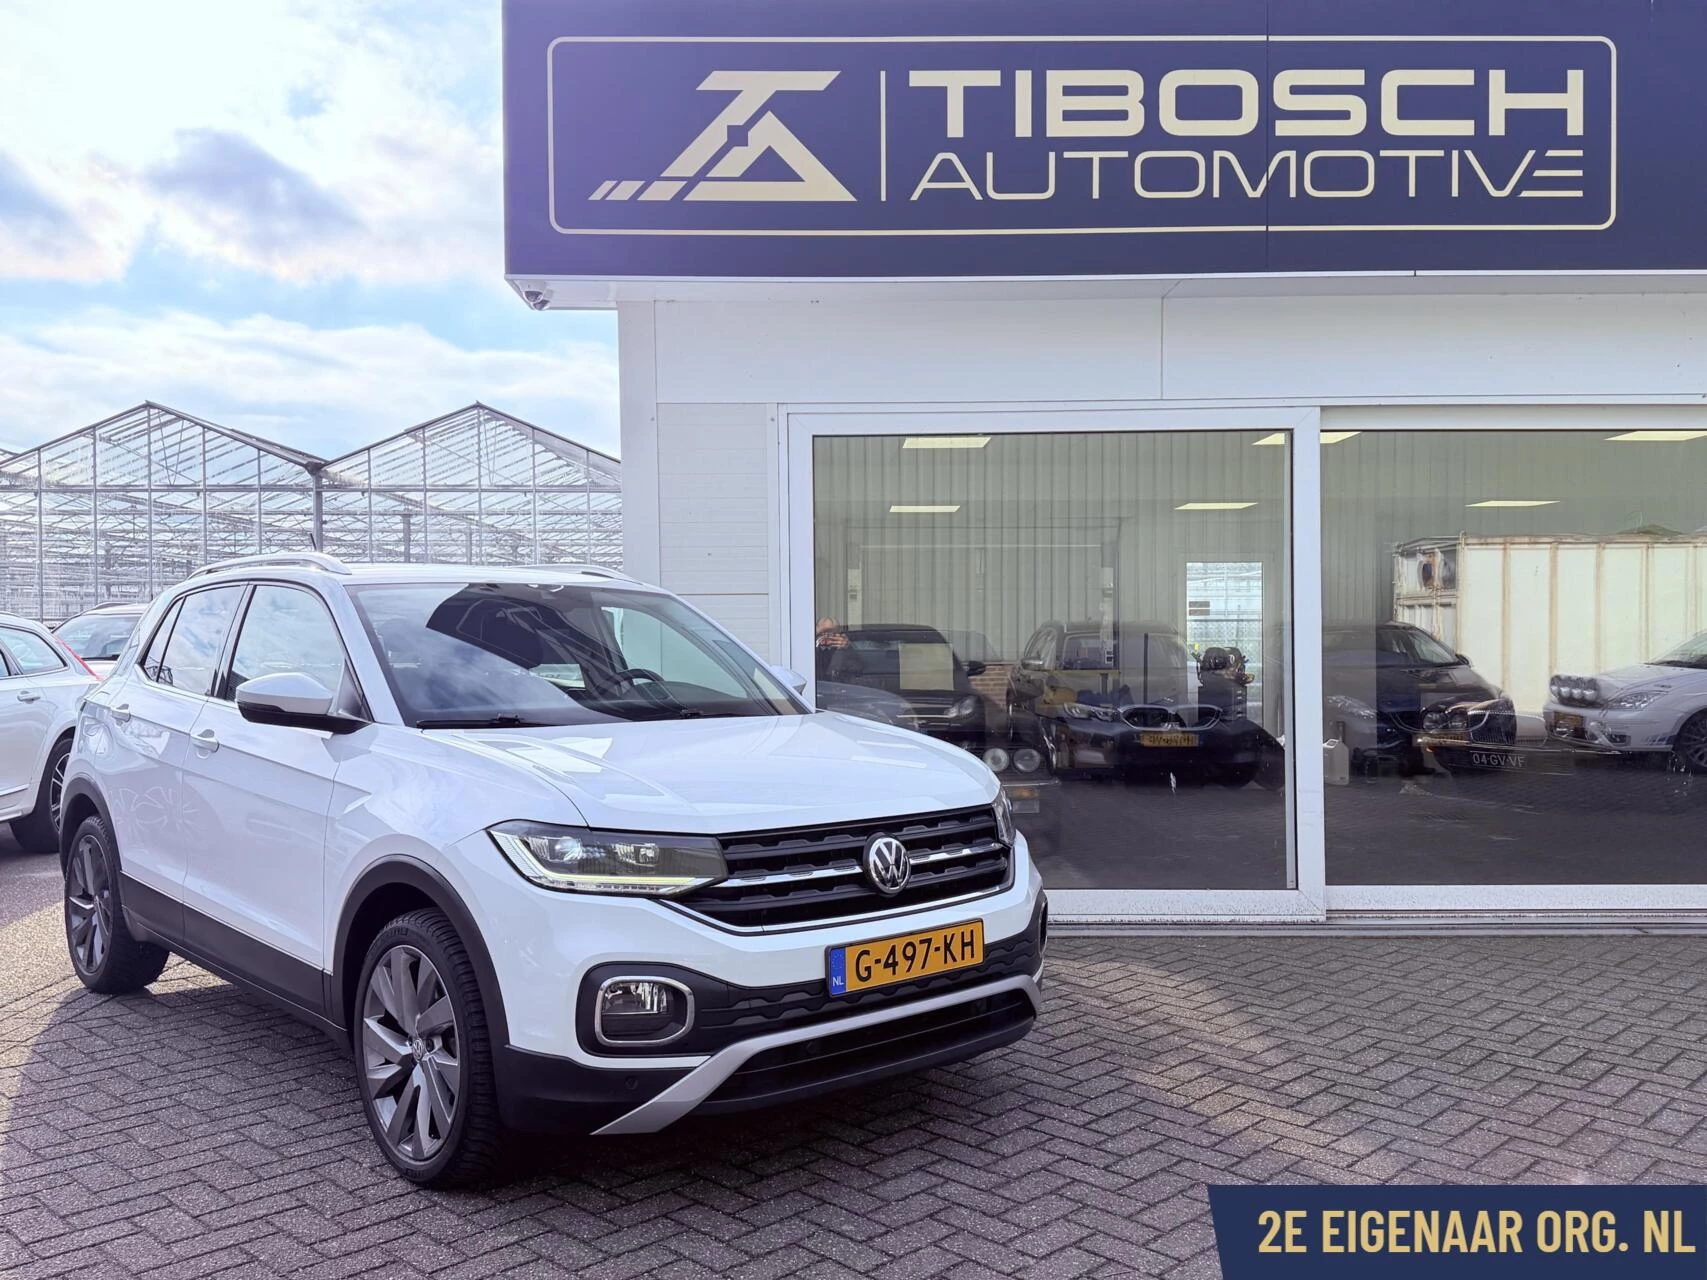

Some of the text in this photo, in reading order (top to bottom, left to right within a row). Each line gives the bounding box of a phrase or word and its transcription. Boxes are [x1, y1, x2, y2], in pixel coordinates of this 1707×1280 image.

[908, 69, 1584, 138] TIBOSCH
[909, 149, 1584, 202] AUTOMOTIVE
[832, 928, 975, 986] NL G-497-KH
